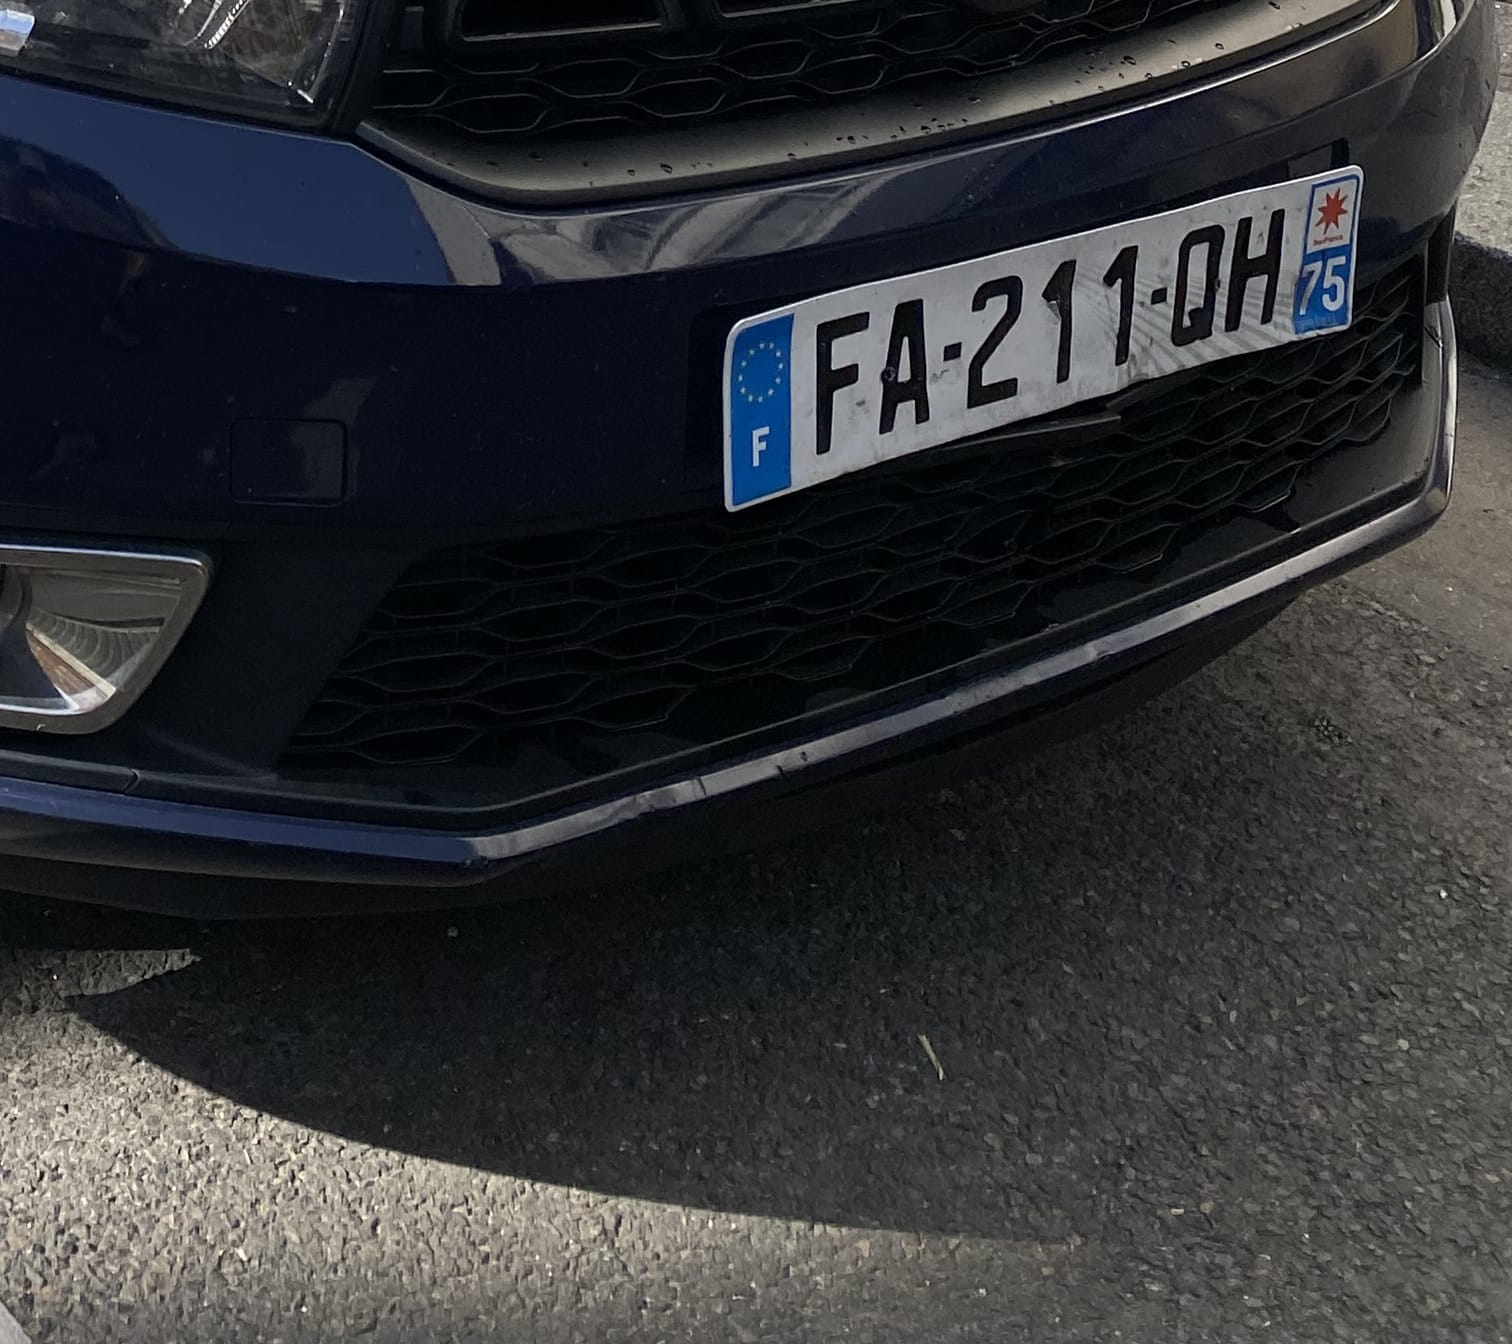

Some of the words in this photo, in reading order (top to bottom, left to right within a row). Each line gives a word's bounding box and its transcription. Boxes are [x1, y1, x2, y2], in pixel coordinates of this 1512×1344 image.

[1298, 255, 1347, 317] 75
[814, 208, 1287, 455] FA-211-QH
[752, 425, 770, 468] F
